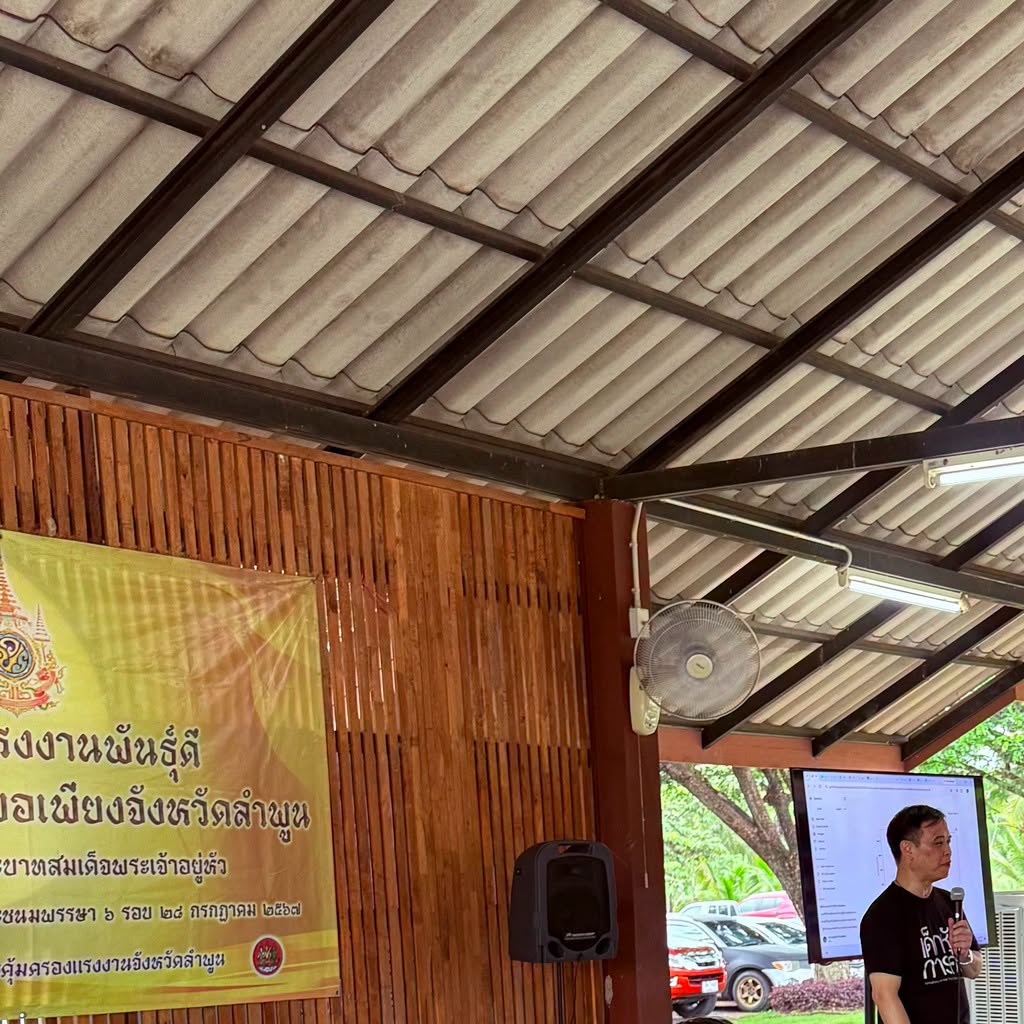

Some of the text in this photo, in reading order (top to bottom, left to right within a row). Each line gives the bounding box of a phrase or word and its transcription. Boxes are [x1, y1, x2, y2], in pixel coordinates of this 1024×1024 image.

[0, 850, 227, 884] บาทสมเด็จพระเจ้าอยู่หัว
[0, 901, 302, 924] ชนมพรรษา ๖ รอบ ๒๘ กรกฎาคม ๒๕๖๗
